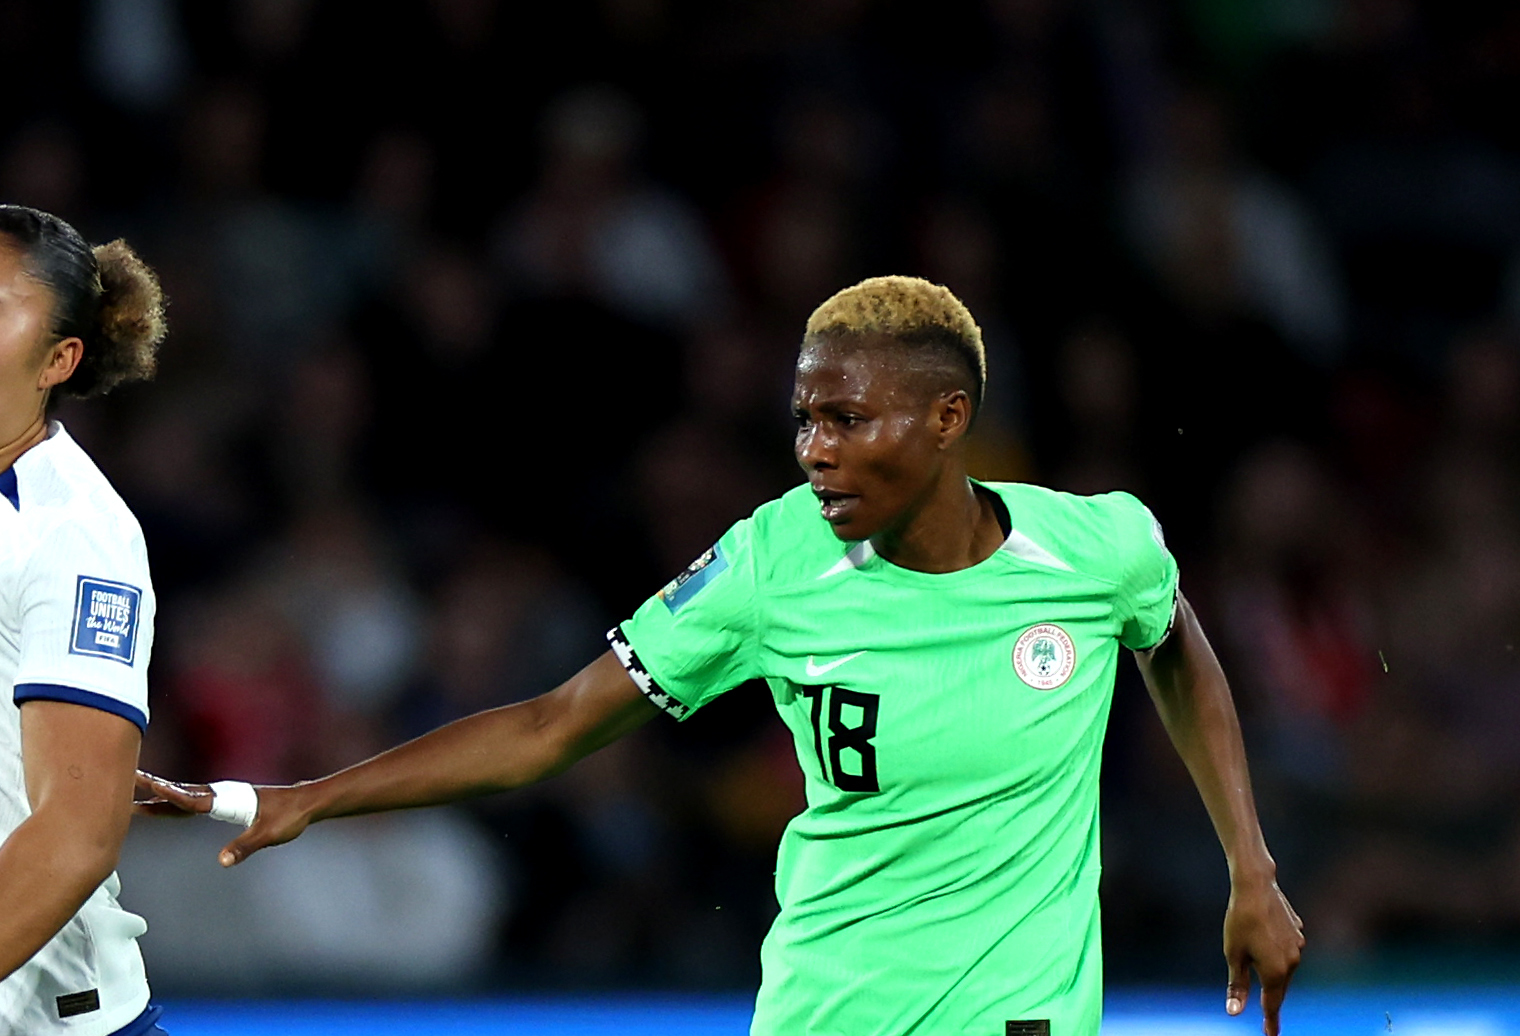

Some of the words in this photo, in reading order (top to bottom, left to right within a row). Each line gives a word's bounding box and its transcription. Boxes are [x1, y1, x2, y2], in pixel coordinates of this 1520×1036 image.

[92, 590, 130, 608] FOOTBALL
[90, 601, 130, 623] UNITES
[86, 616, 102, 628] the
[103, 618, 130, 637] World
[1020, 627, 1056, 645] FOOTBALL
[1057, 632, 1072, 677] FEDERATION
[802, 684, 880, 793] 18
